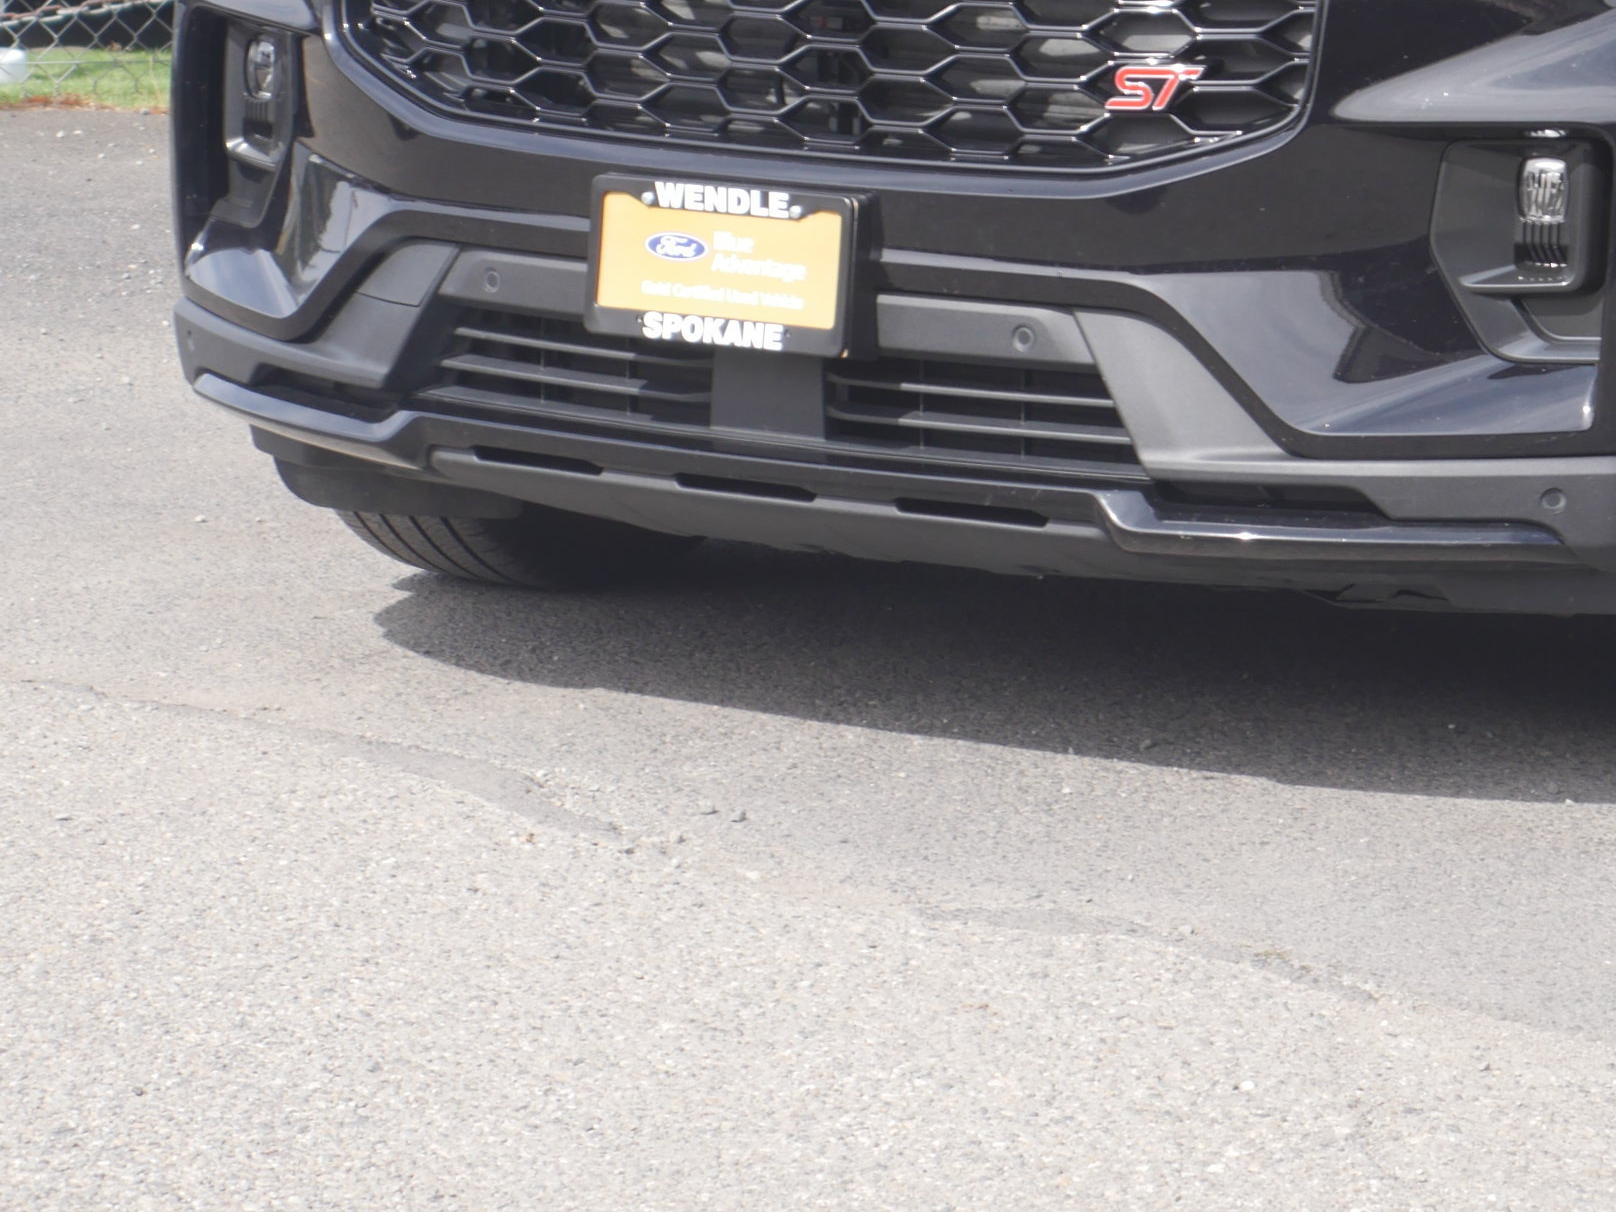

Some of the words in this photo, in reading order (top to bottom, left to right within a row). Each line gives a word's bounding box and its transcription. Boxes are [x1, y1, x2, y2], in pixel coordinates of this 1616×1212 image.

[1105, 62, 1207, 112] ST
[654, 181, 790, 218] WENDLE
[656, 235, 697, 258] Ford
[642, 311, 783, 350] SPOKANE
